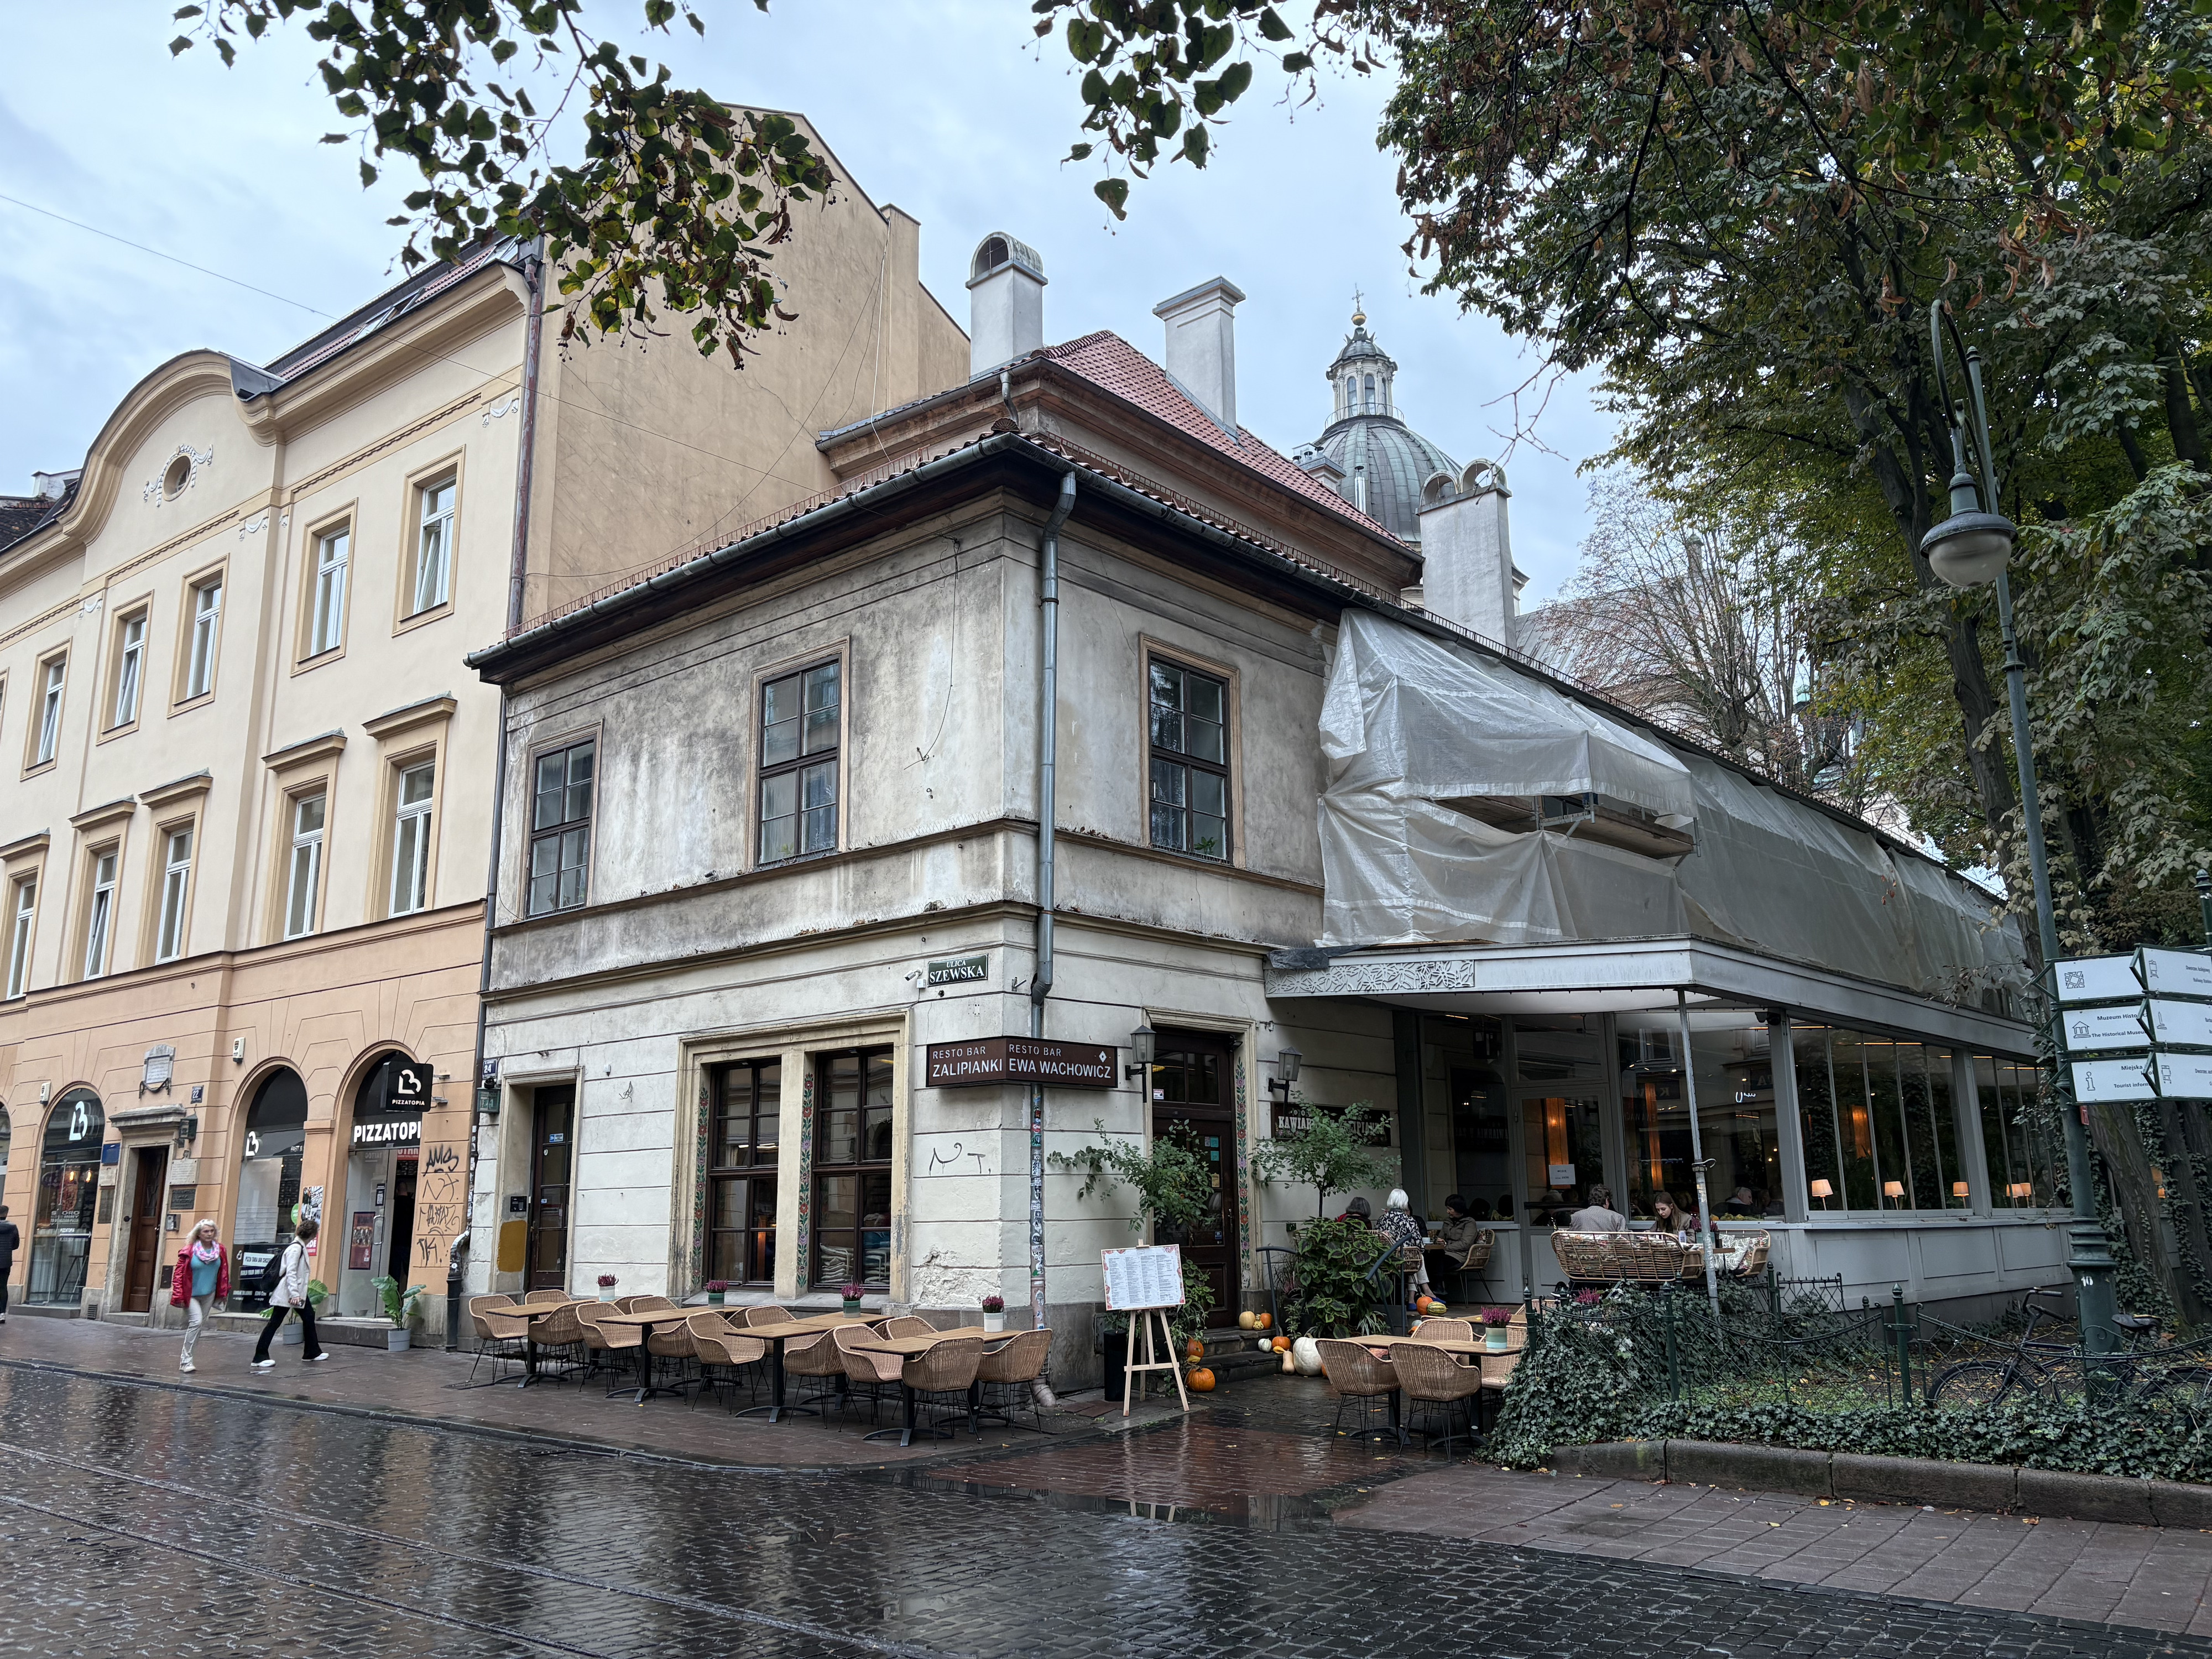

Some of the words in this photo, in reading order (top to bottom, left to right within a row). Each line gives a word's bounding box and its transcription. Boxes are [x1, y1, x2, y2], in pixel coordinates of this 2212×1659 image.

[946, 959, 966, 968] ULICA
[930, 965, 985, 983] SZEWSKA
[933, 1048, 963, 1060] RESTO
[967, 1046, 986, 1056] BAR
[1009, 1044, 1040, 1055] RESTO
[1044, 1047, 1062, 1057] BAR
[484, 1064, 492, 1073] 24
[933, 1058, 1002, 1077] ZALIPIANKI
[1009, 1058, 1036, 1073] EWA
[1040, 1061, 1111, 1078] WACHOWICZ
[192, 1089, 199, 1099] 22
[1278, 1116, 1312, 1130] KAWIAR
[353, 1121, 421, 1142] PIZZATOPI
[2080, 1276, 2094, 1287] 10
